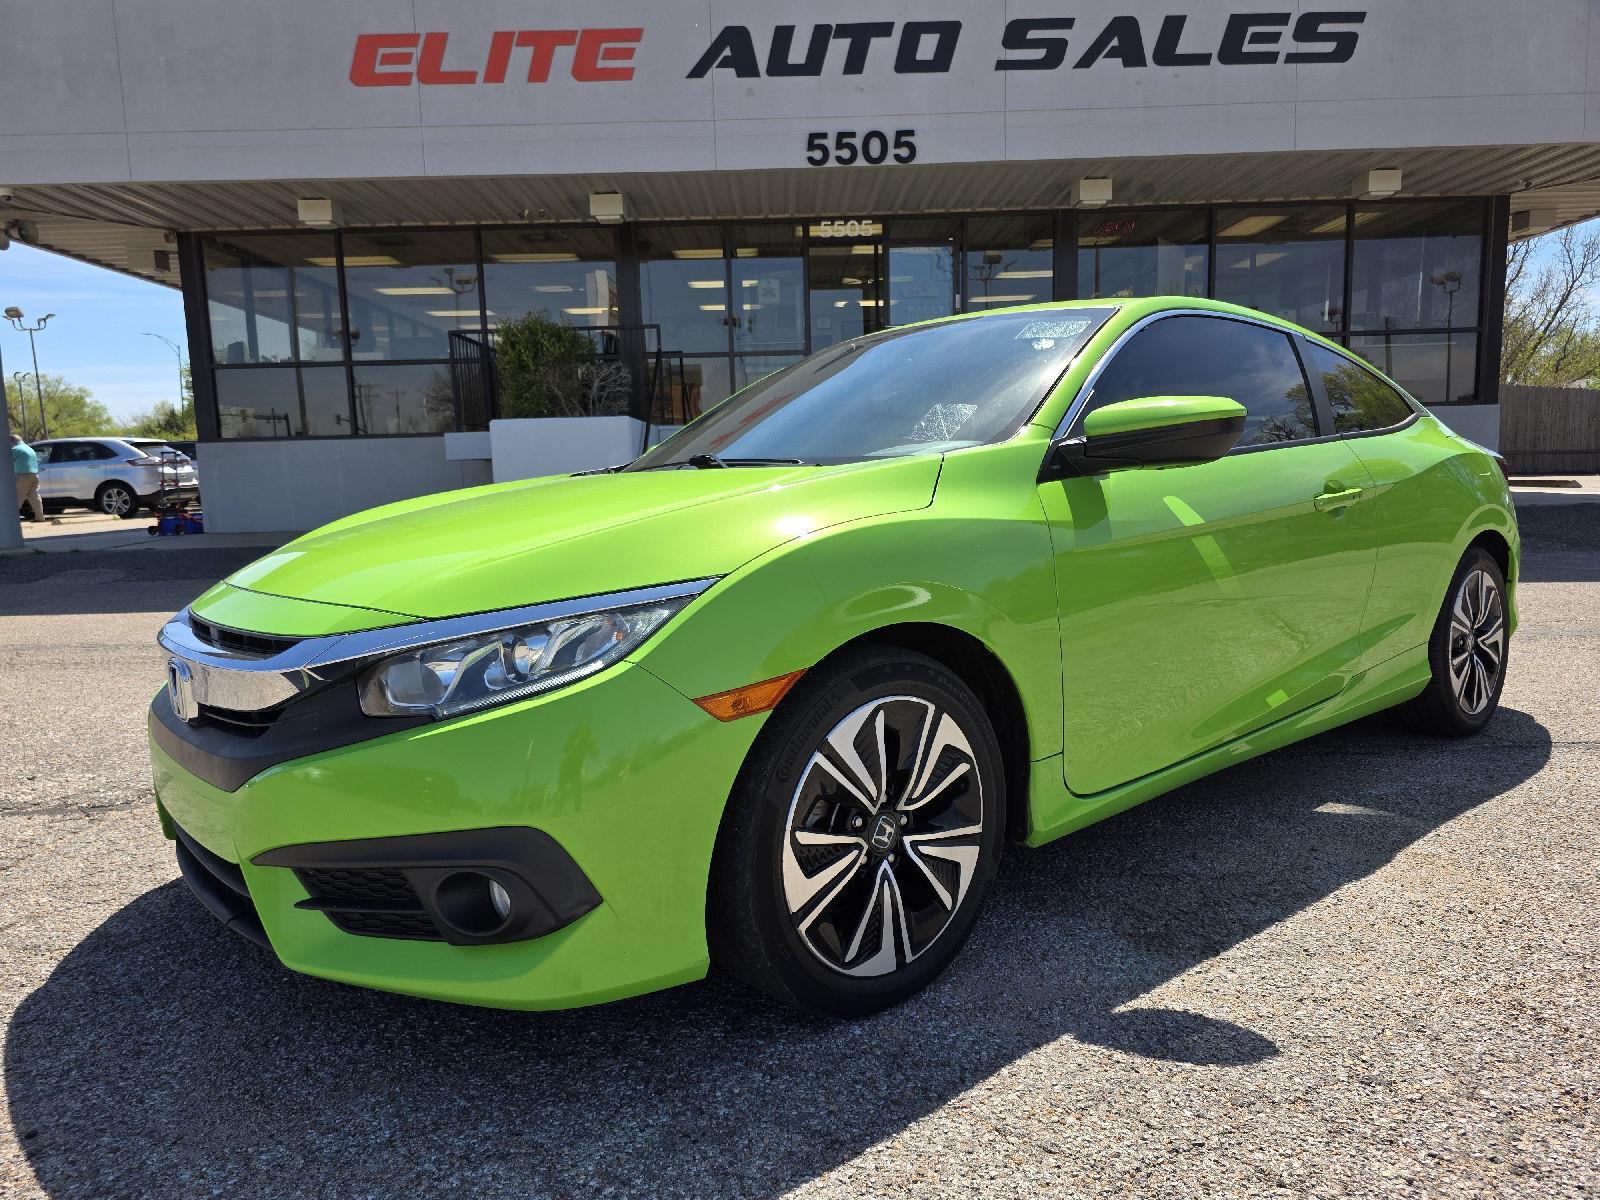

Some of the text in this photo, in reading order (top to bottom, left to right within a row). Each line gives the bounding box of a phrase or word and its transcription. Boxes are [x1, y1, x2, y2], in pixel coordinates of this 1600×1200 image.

[350, 11, 1368, 87] ELITE AUTO SALES
[806, 129, 917, 167] 5505
[819, 219, 874, 238] 5505
